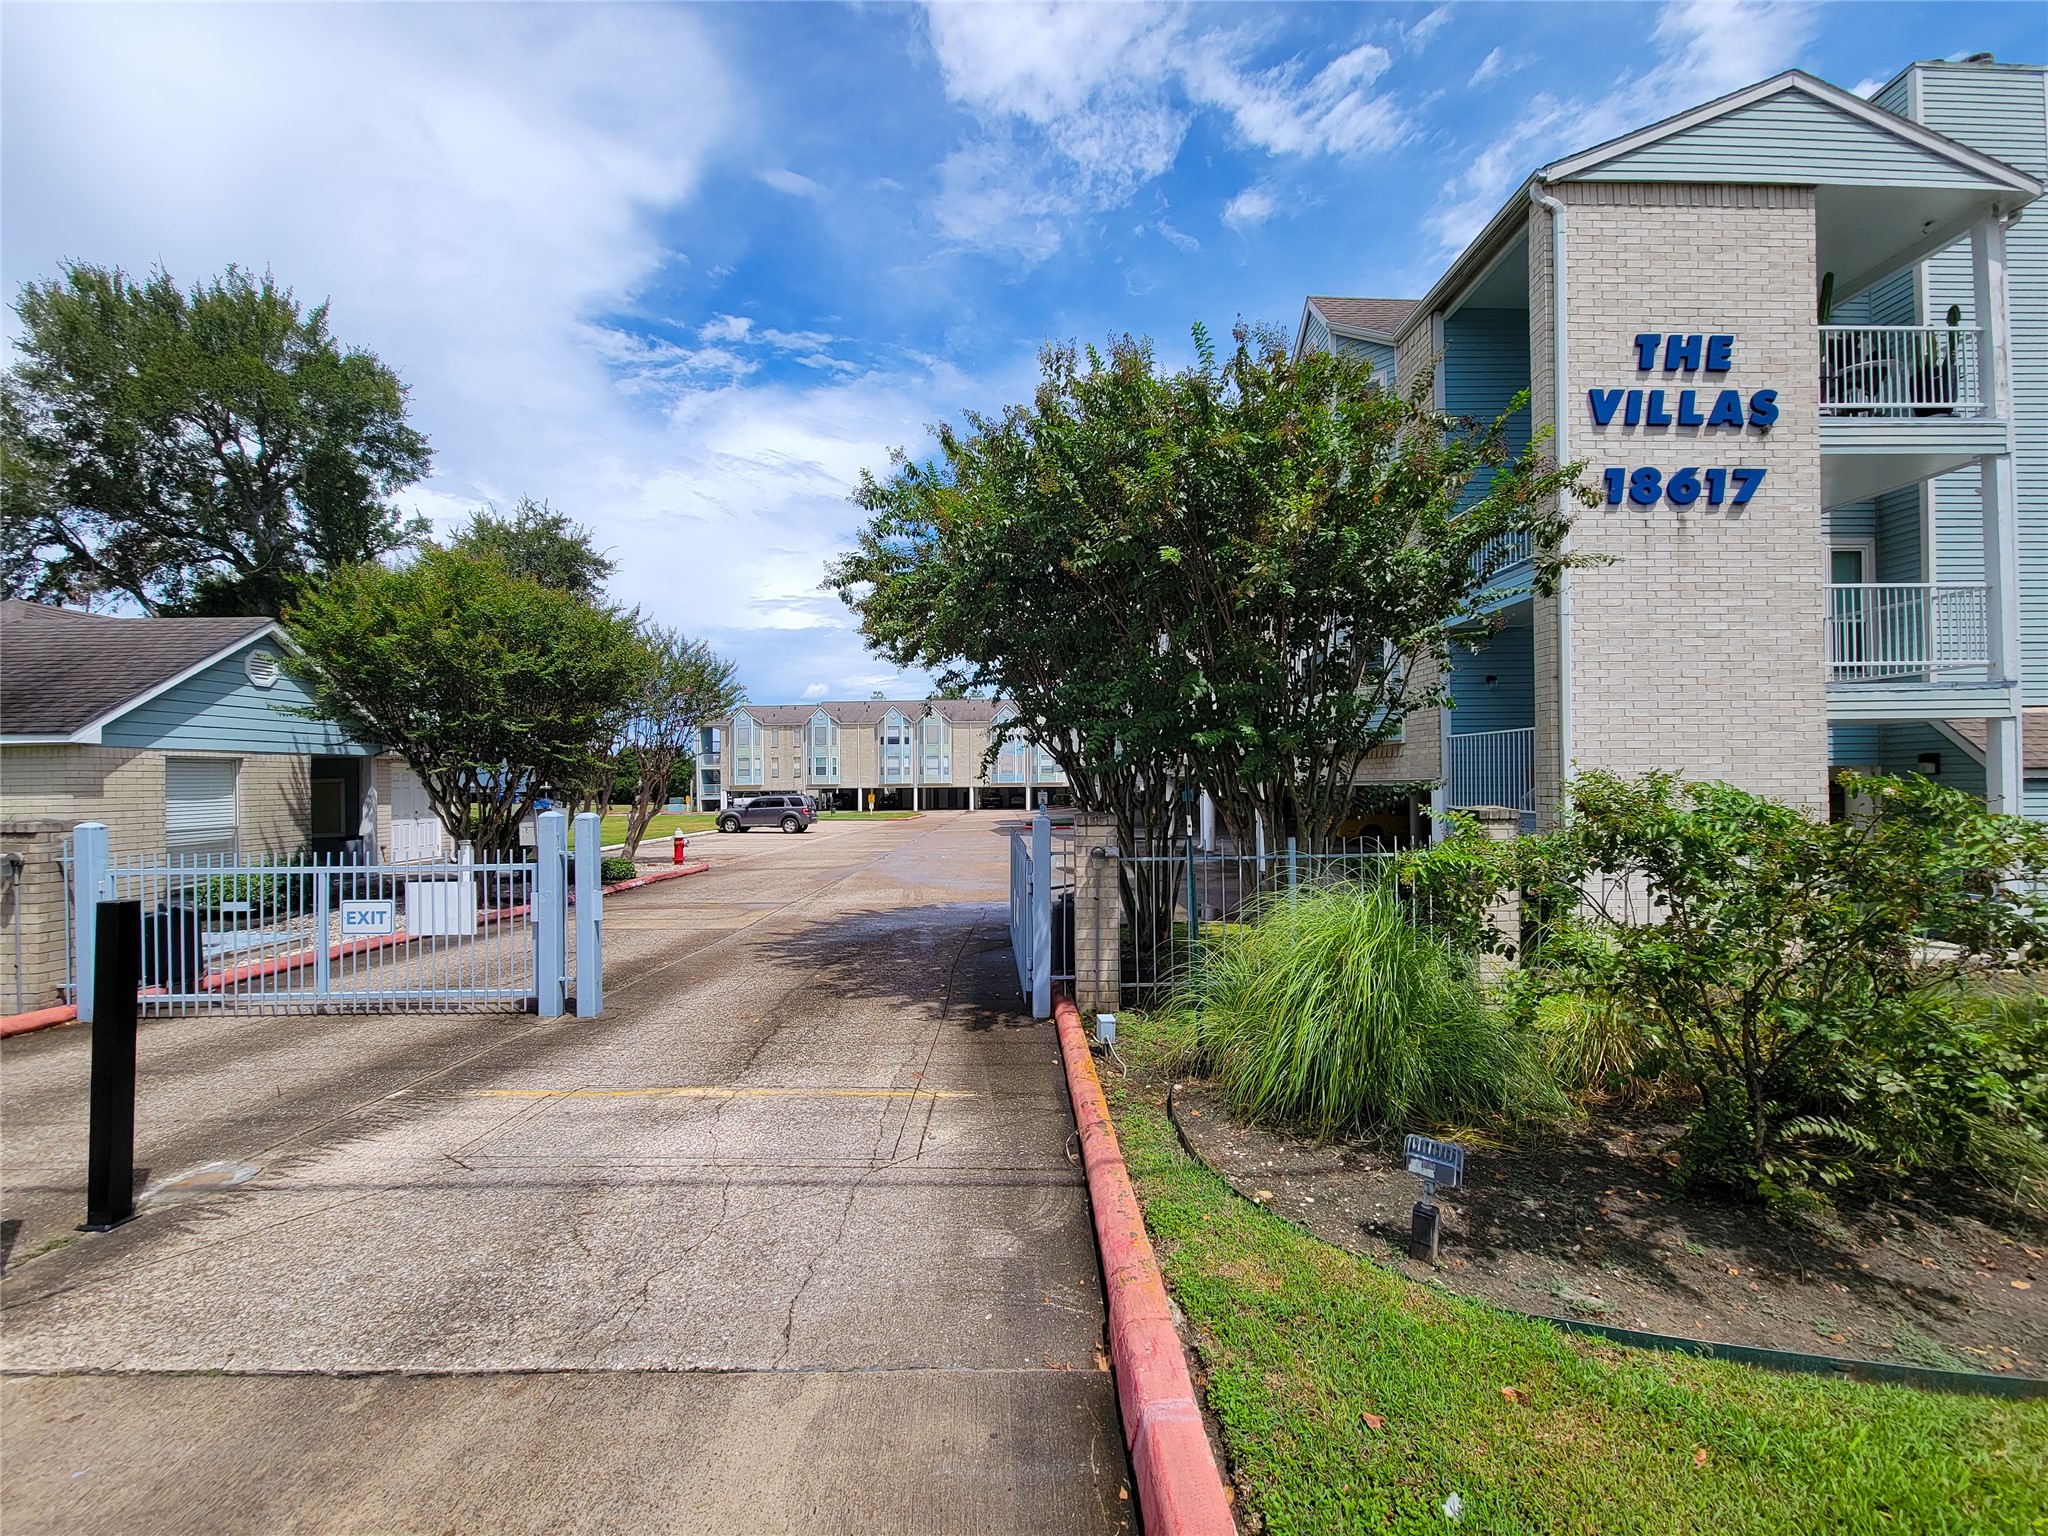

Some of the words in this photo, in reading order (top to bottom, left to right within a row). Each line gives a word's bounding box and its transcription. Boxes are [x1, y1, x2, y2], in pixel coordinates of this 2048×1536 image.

[1634, 333, 1735, 372] THE
[1588, 388, 1780, 428] VILLAS
[1604, 466, 1768, 506] 18617
[346, 910, 387, 925] EXIT
